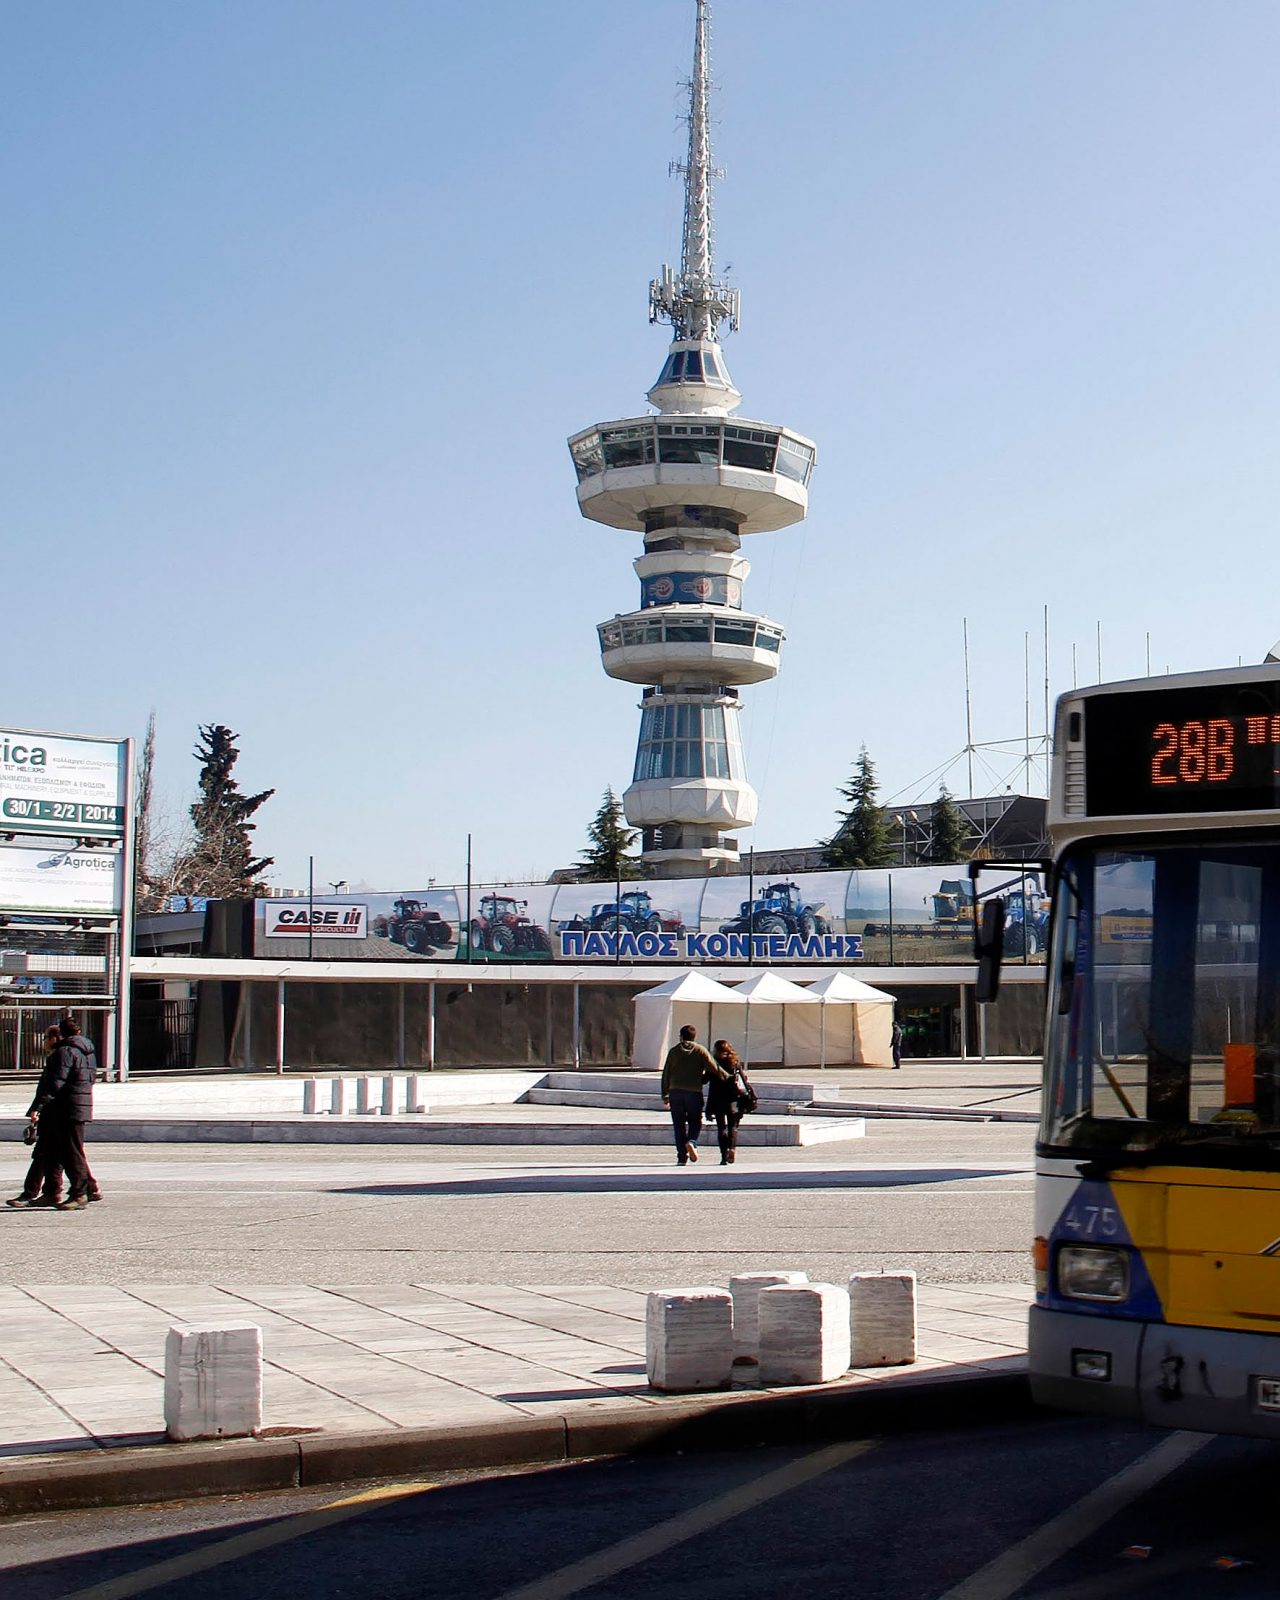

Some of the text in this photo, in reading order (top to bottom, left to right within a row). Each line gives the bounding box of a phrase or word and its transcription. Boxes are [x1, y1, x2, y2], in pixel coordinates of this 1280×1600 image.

[0, 738, 47, 766] ica
[1151, 718, 1235, 784] 28B
[9, 799, 40, 816] 30/1
[53, 803, 76, 819] 2/2
[85, 806, 117, 821] 2014
[64, 856, 115, 869] Agrotica
[278, 910, 339, 924] CASE
[560, 931, 864, 958] ΠΑΥΛΟΣ ΚΟΝΤΕΛΛΗΣ
[1065, 1206, 1117, 1235] 475
